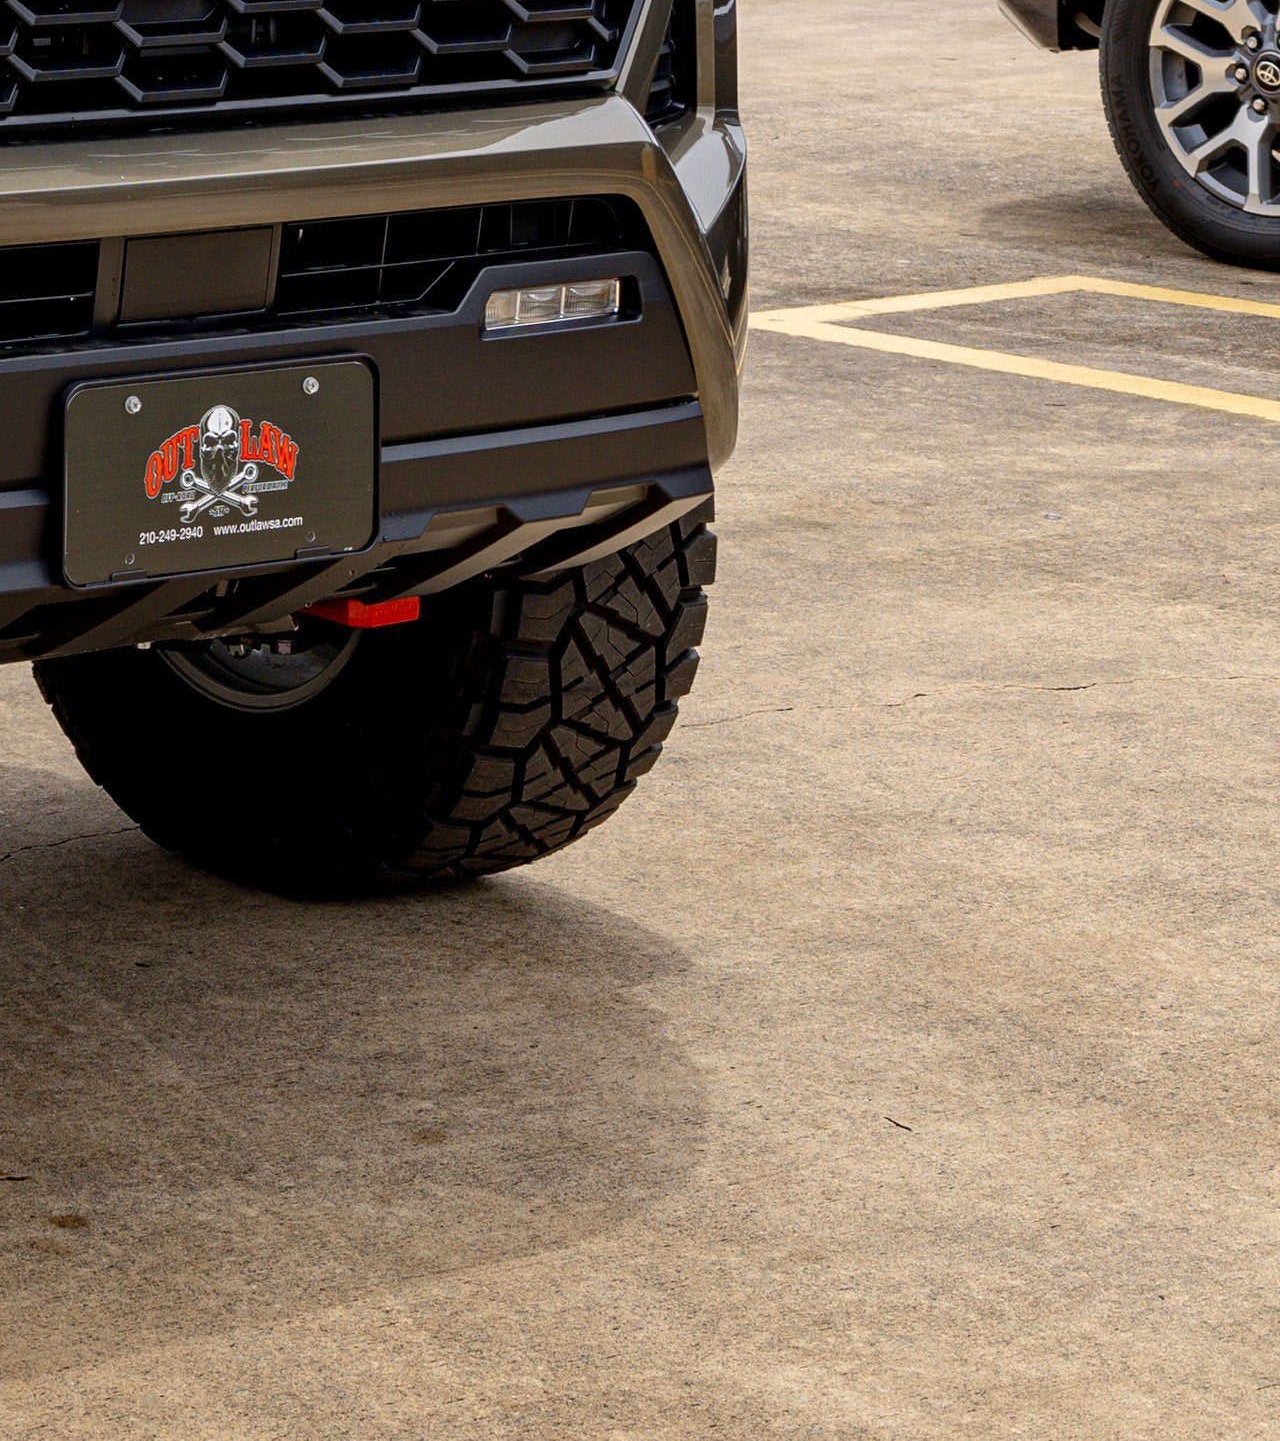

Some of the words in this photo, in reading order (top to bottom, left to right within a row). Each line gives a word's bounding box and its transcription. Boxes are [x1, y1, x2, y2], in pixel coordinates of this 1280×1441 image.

[1111, 73, 1162, 193] YOKOHAMA
[139, 525, 204, 545] 210-249-2940
[213, 516, 303, 536] www.outlawsa.com
